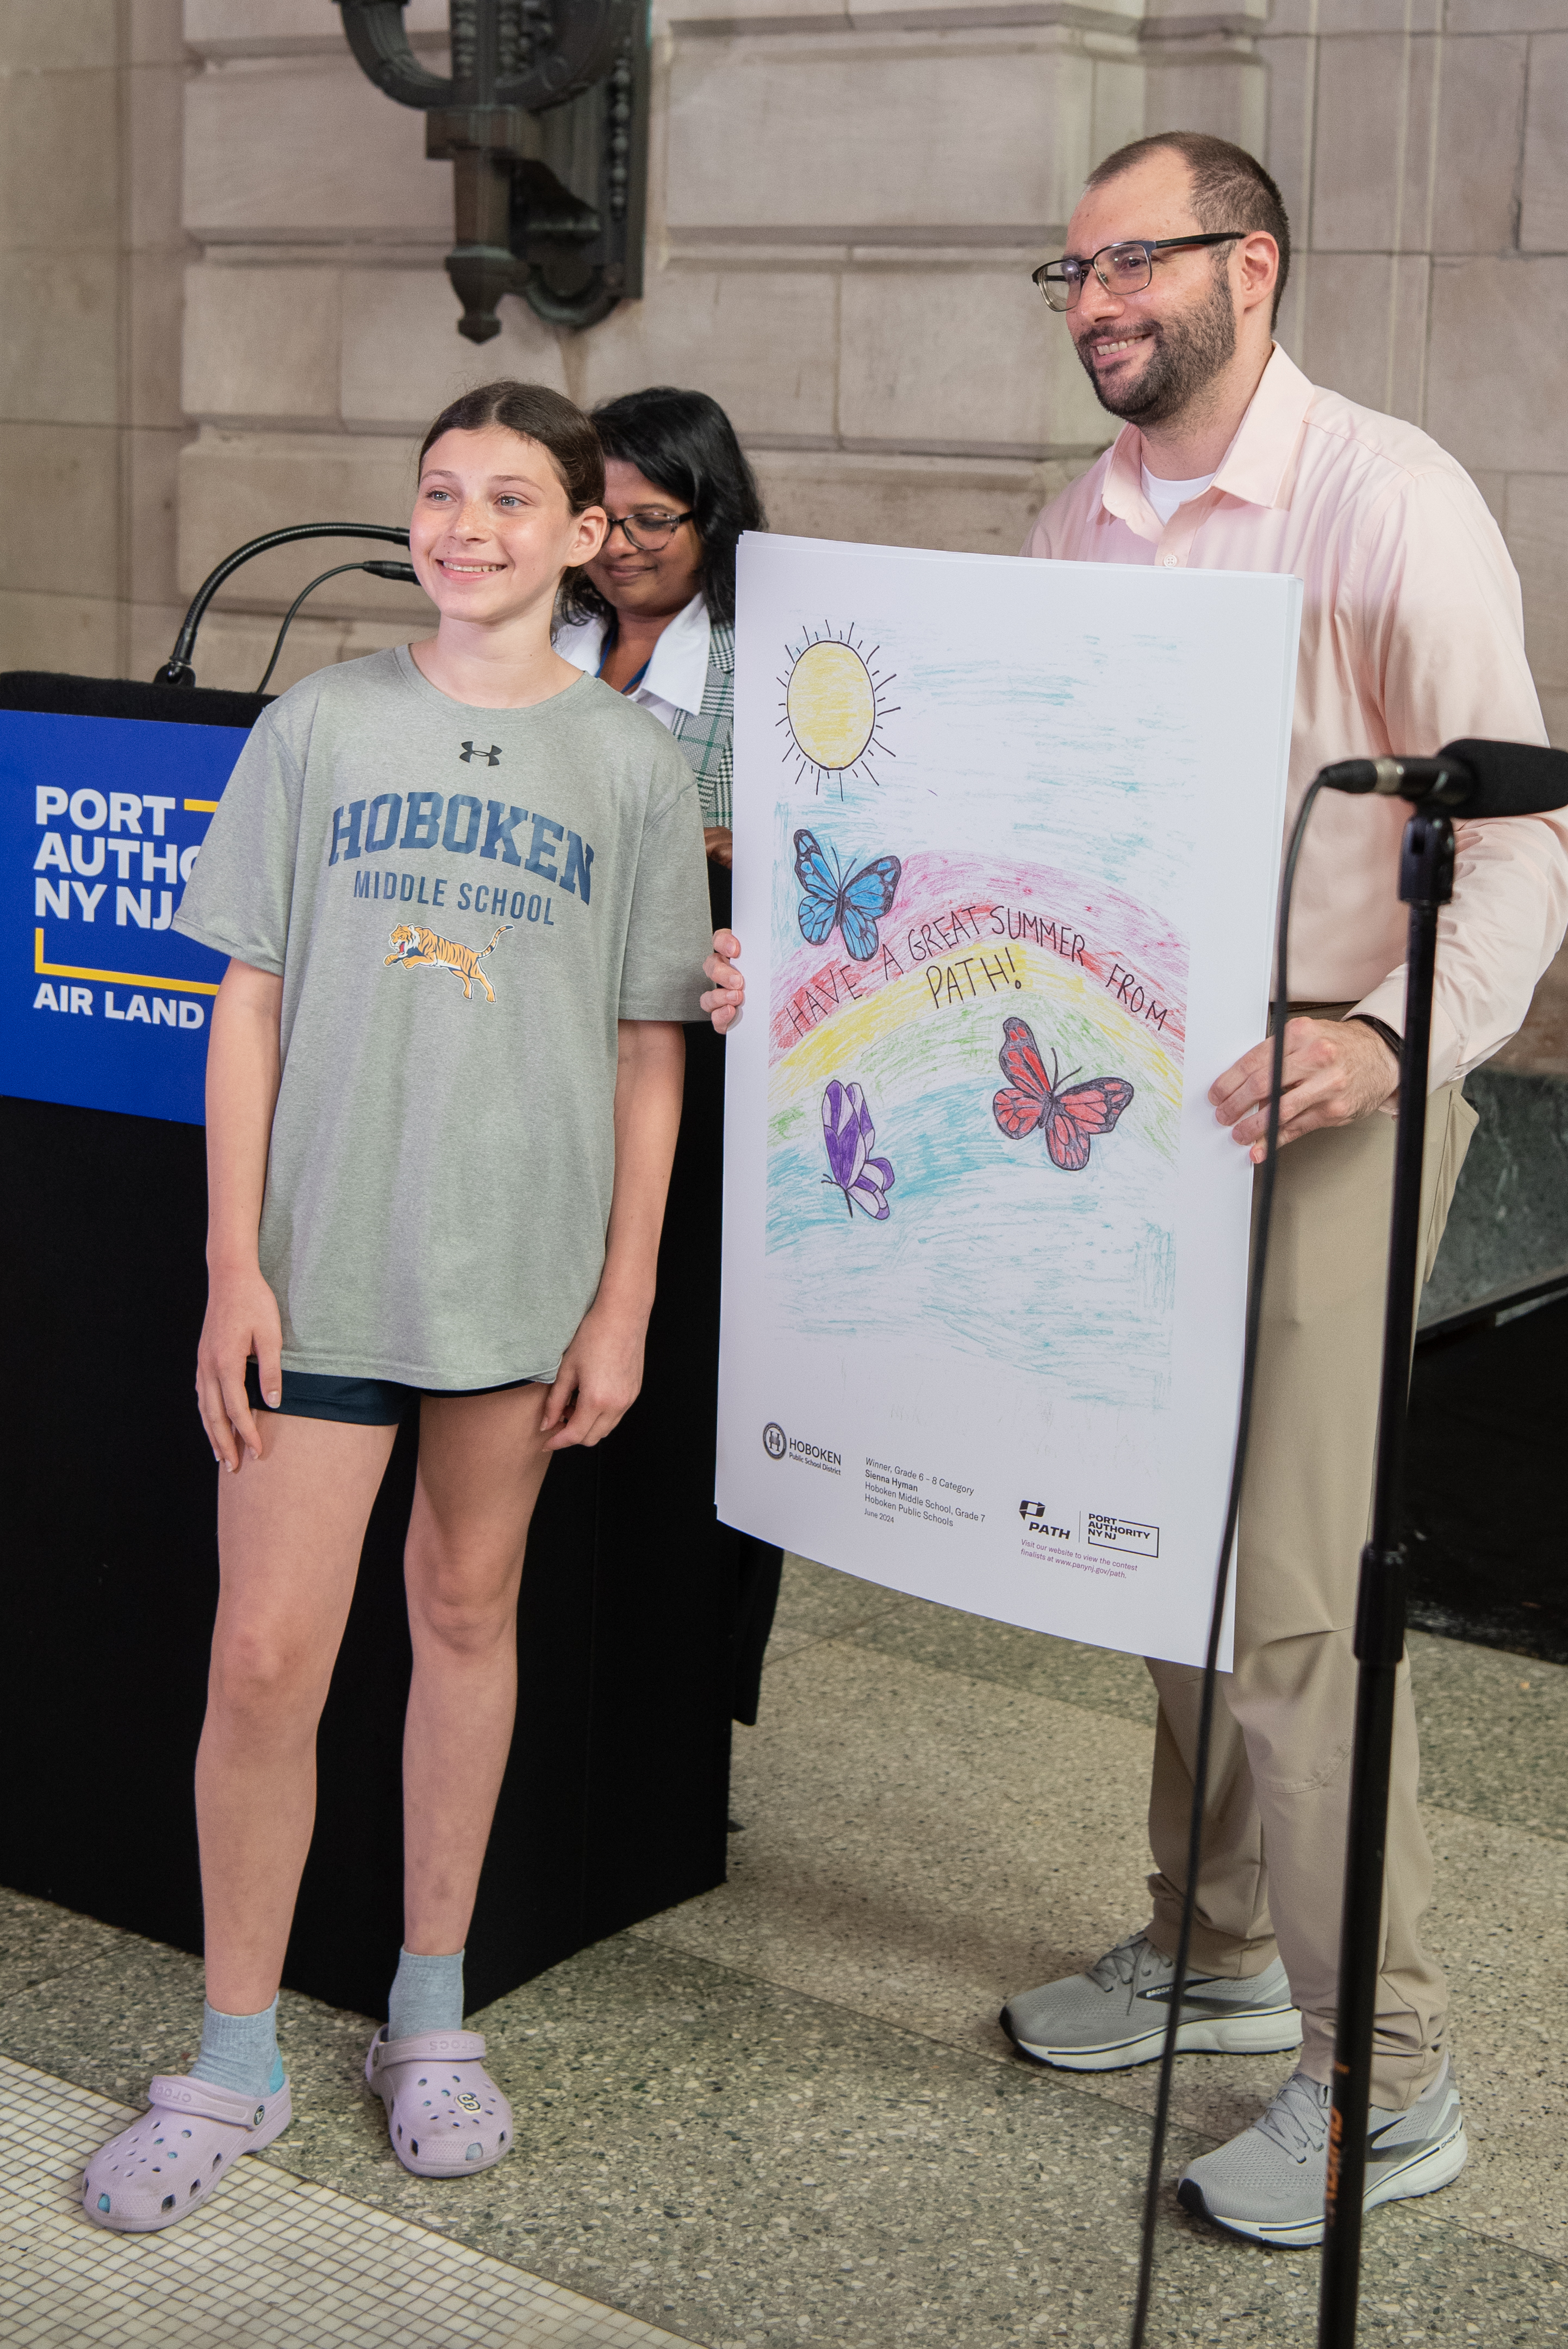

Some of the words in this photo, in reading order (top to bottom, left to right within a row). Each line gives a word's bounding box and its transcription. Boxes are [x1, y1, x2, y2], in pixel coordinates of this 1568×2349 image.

[36, 785, 176, 836] PORT
[328, 792, 594, 905] HOBOKEN
[35, 877, 108, 922] NY
[116, 886, 172, 930] NJ
[353, 870, 447, 907] MIDDLE
[457, 883, 554, 925] SCHOOL
[786, 965, 863, 1037] HAVE
[882, 943, 904, 980] A
[908, 906, 980, 961] GREAT
[990, 905, 1085, 966] SUMMER
[1105, 964, 1168, 1031] FROM
[926, 947, 1022, 1009] PATH!
[33, 983, 93, 1015] AIR
[105, 991, 204, 1029] LAND
[789, 1437, 841, 1466] HOBOKEN
[789, 1452, 804, 1463] Public
[805, 1457, 822, 1469] School
[823, 1463, 841, 1476] District
[865, 1469, 890, 1484] Sienna
[892, 1477, 918, 1492] Hyman
[866, 1457, 892, 1473] Winner,
[894, 1466, 917, 1479] Grade
[919, 1473, 924, 1481] 6
[932, 1476, 937, 1484] 8
[939, 1478, 974, 1496] Category
[864, 1508, 878, 1518] June
[879, 1513, 894, 1523] 2024
[865, 1481, 897, 1498] Hoboken
[899, 1492, 923, 1506] Middle
[925, 1499, 953, 1515] School,
[955, 1508, 979, 1520] Grade
[981, 1514, 985, 1522] 7
[865, 1493, 897, 1510] Hoboken
[899, 1504, 921, 1518] Public
[923, 1511, 953, 1526] Schools
[1029, 1521, 1071, 1539] PATH
[1088, 1513, 1117, 1525] PORT
[1088, 1521, 1150, 1539] AUTHORITY
[1088, 1528, 1103, 1537] NY
[1104, 1532, 1116, 1540] NJ
[1021, 1539, 1035, 1548] Visit
[1036, 1543, 1047, 1551] our
[1049, 1546, 1073, 1557] website
[1083, 1554, 1098, 1563] view
[1099, 1557, 1111, 1565] the
[1112, 1561, 1138, 1571] contest
[1021, 1548, 1046, 1561] finalists
[1055, 1557, 1127, 1579] www.panynj.gov/path.
